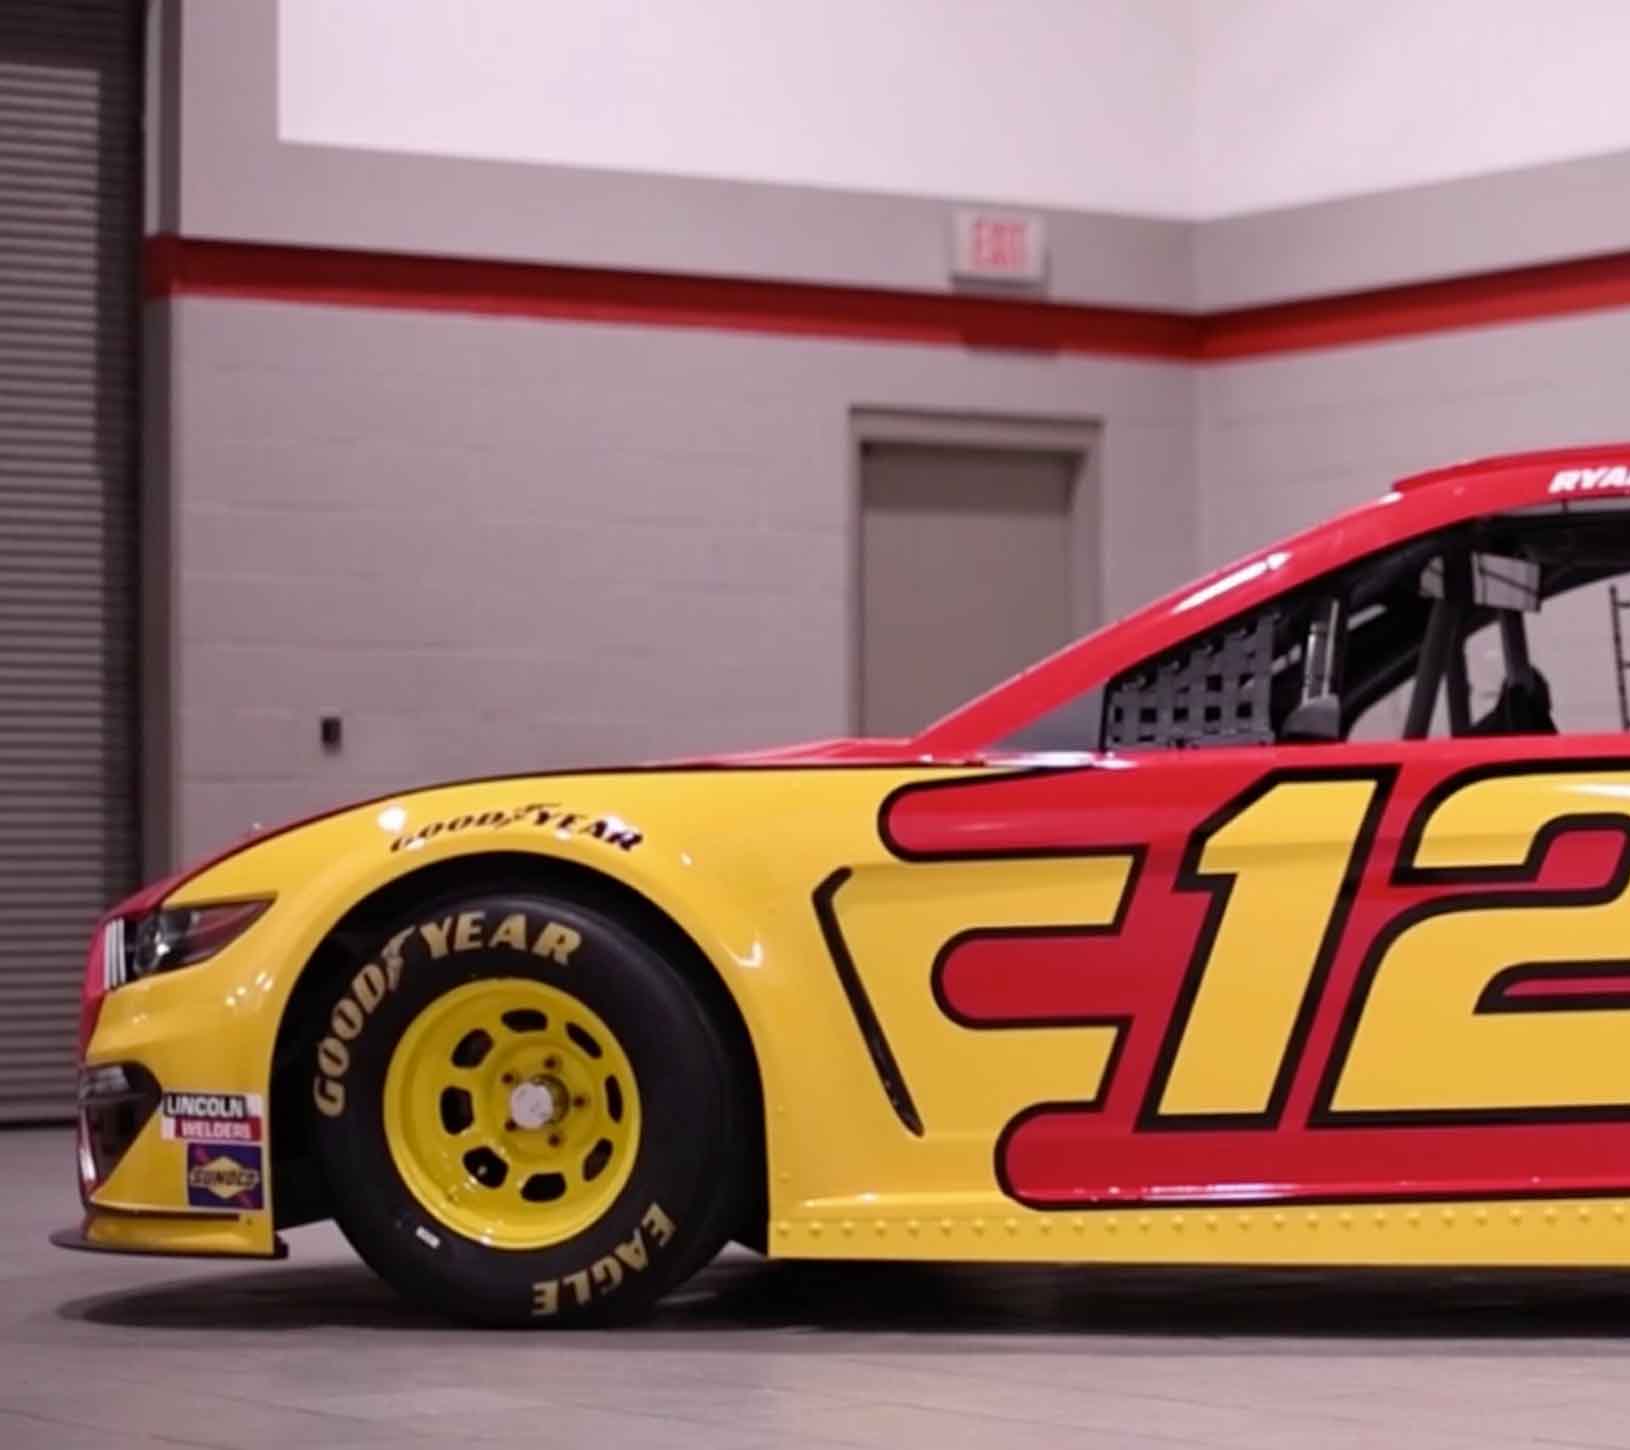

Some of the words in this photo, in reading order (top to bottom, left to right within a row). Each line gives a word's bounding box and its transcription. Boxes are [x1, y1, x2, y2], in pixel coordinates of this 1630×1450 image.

[971, 219, 1028, 269] EXIT
[166, 1093, 245, 1119] LINCOLN
[181, 1119, 252, 1140] WELDERS
[530, 1201, 677, 1316] EAGLE
